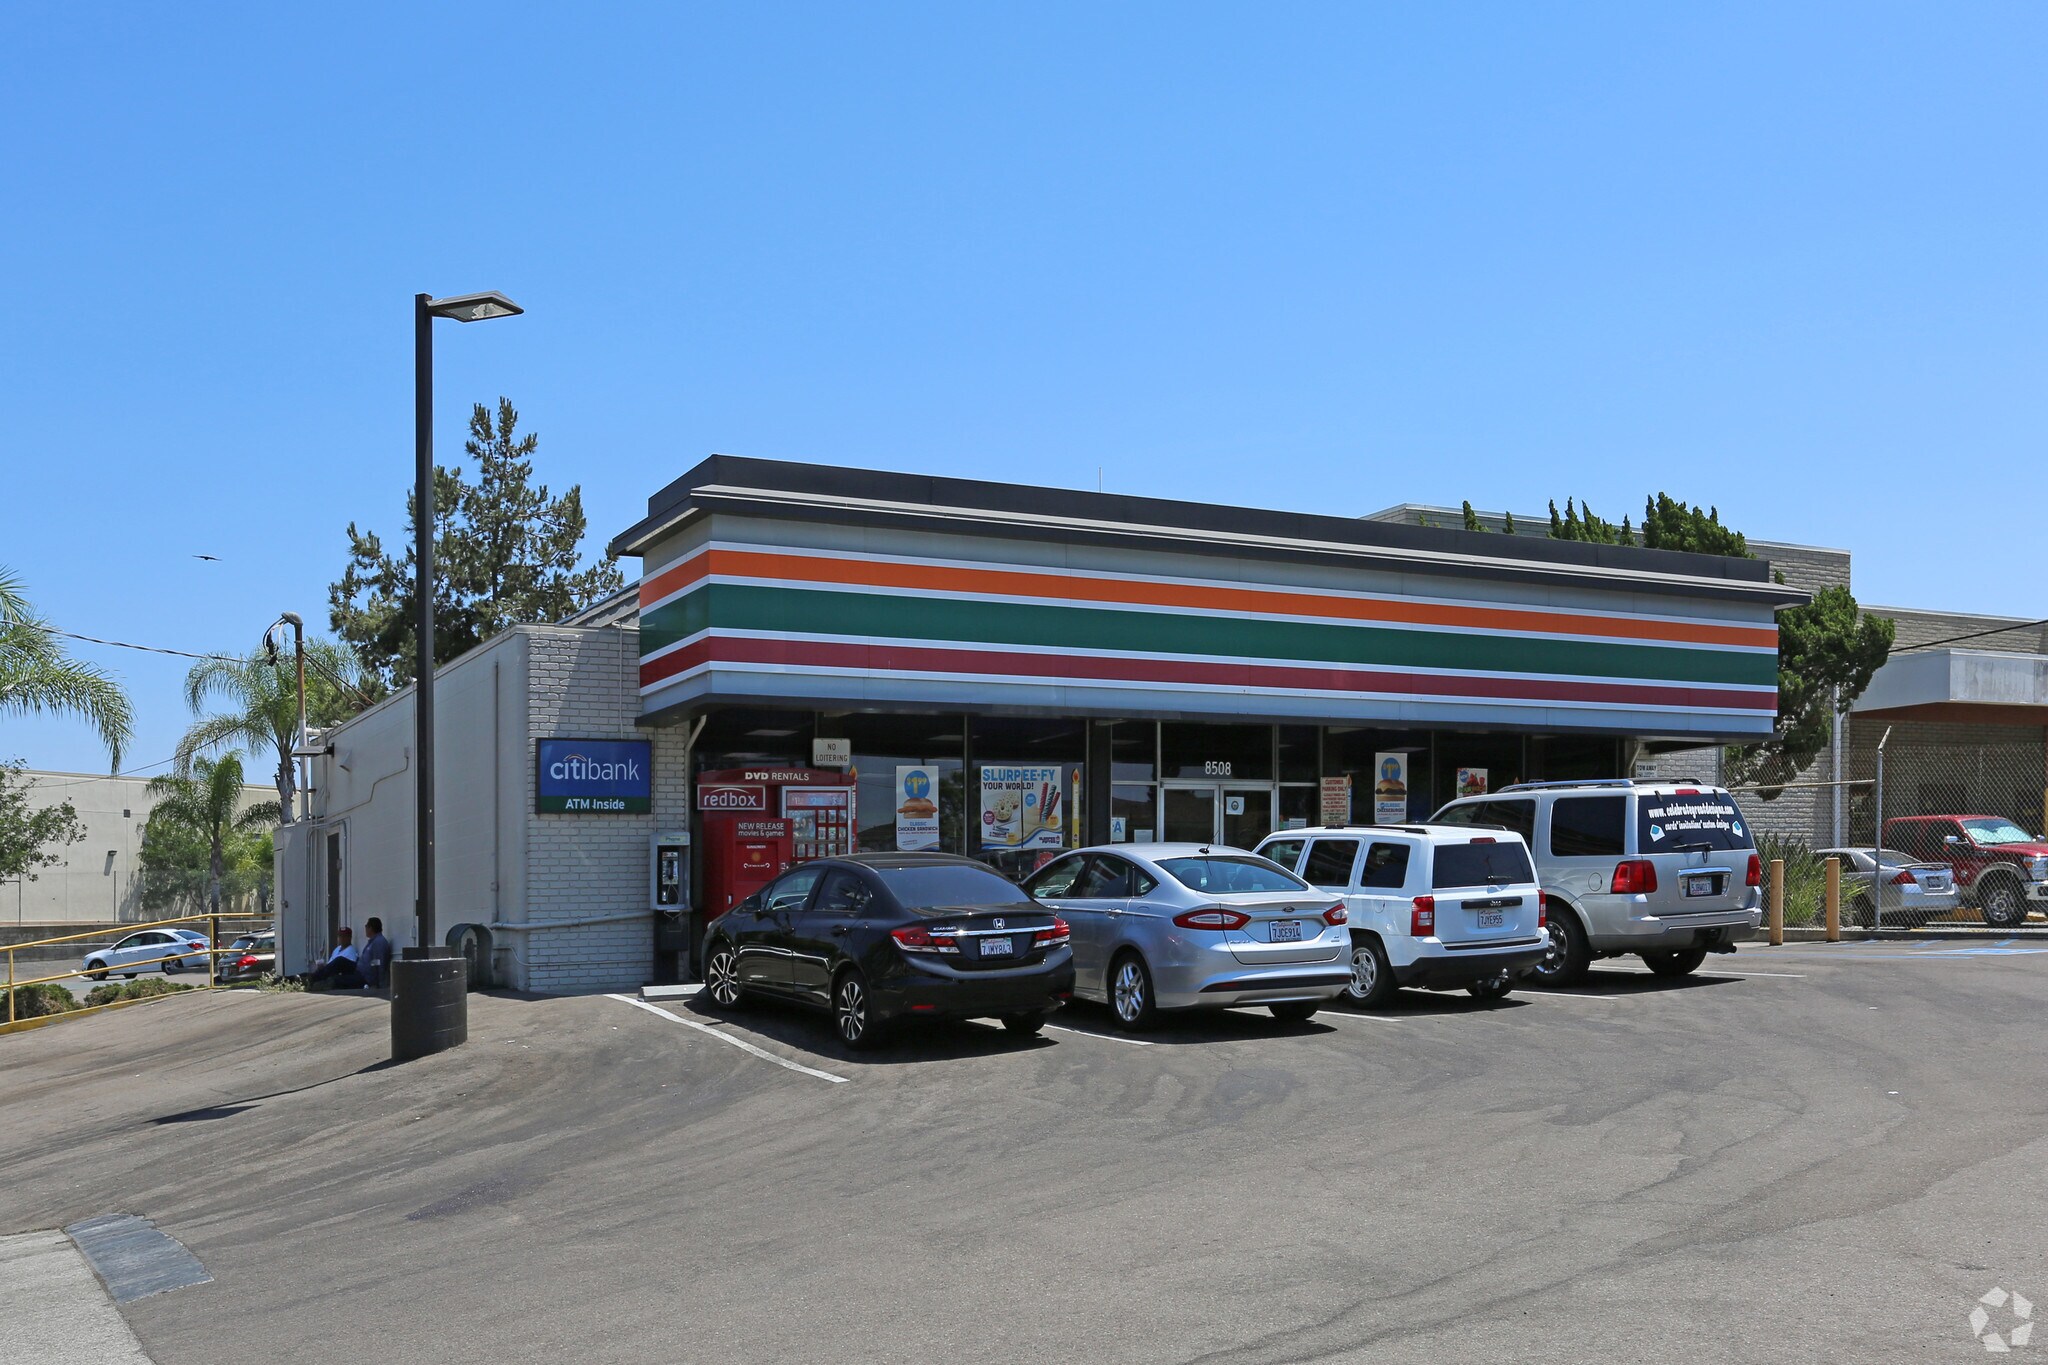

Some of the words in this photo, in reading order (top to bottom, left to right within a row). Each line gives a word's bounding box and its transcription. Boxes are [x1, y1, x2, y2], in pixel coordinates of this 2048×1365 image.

[827, 743, 836, 751] NO
[815, 754, 848, 762] LOITERING
[549, 754, 640, 780] citibank
[1205, 761, 1231, 775] 8508
[745, 772, 769, 780] DVD
[771, 772, 810, 781] RENTALS
[982, 768, 1055, 782] SLURPEE-FY
[983, 782, 1003, 790] YOUR
[1005, 782, 1034, 790] WORLD!
[565, 798, 590, 809] ATM
[593, 798, 625, 809] Inside
[704, 792, 756, 806] redbox
[738, 822, 754, 830] NEW
[755, 822, 784, 830] RELEASE
[1113, 821, 1122, 833] A
[765, 830, 784, 838] games
[1480, 914, 1503, 925] 7JYE955
[1272, 927, 1301, 938] 7JCE914
